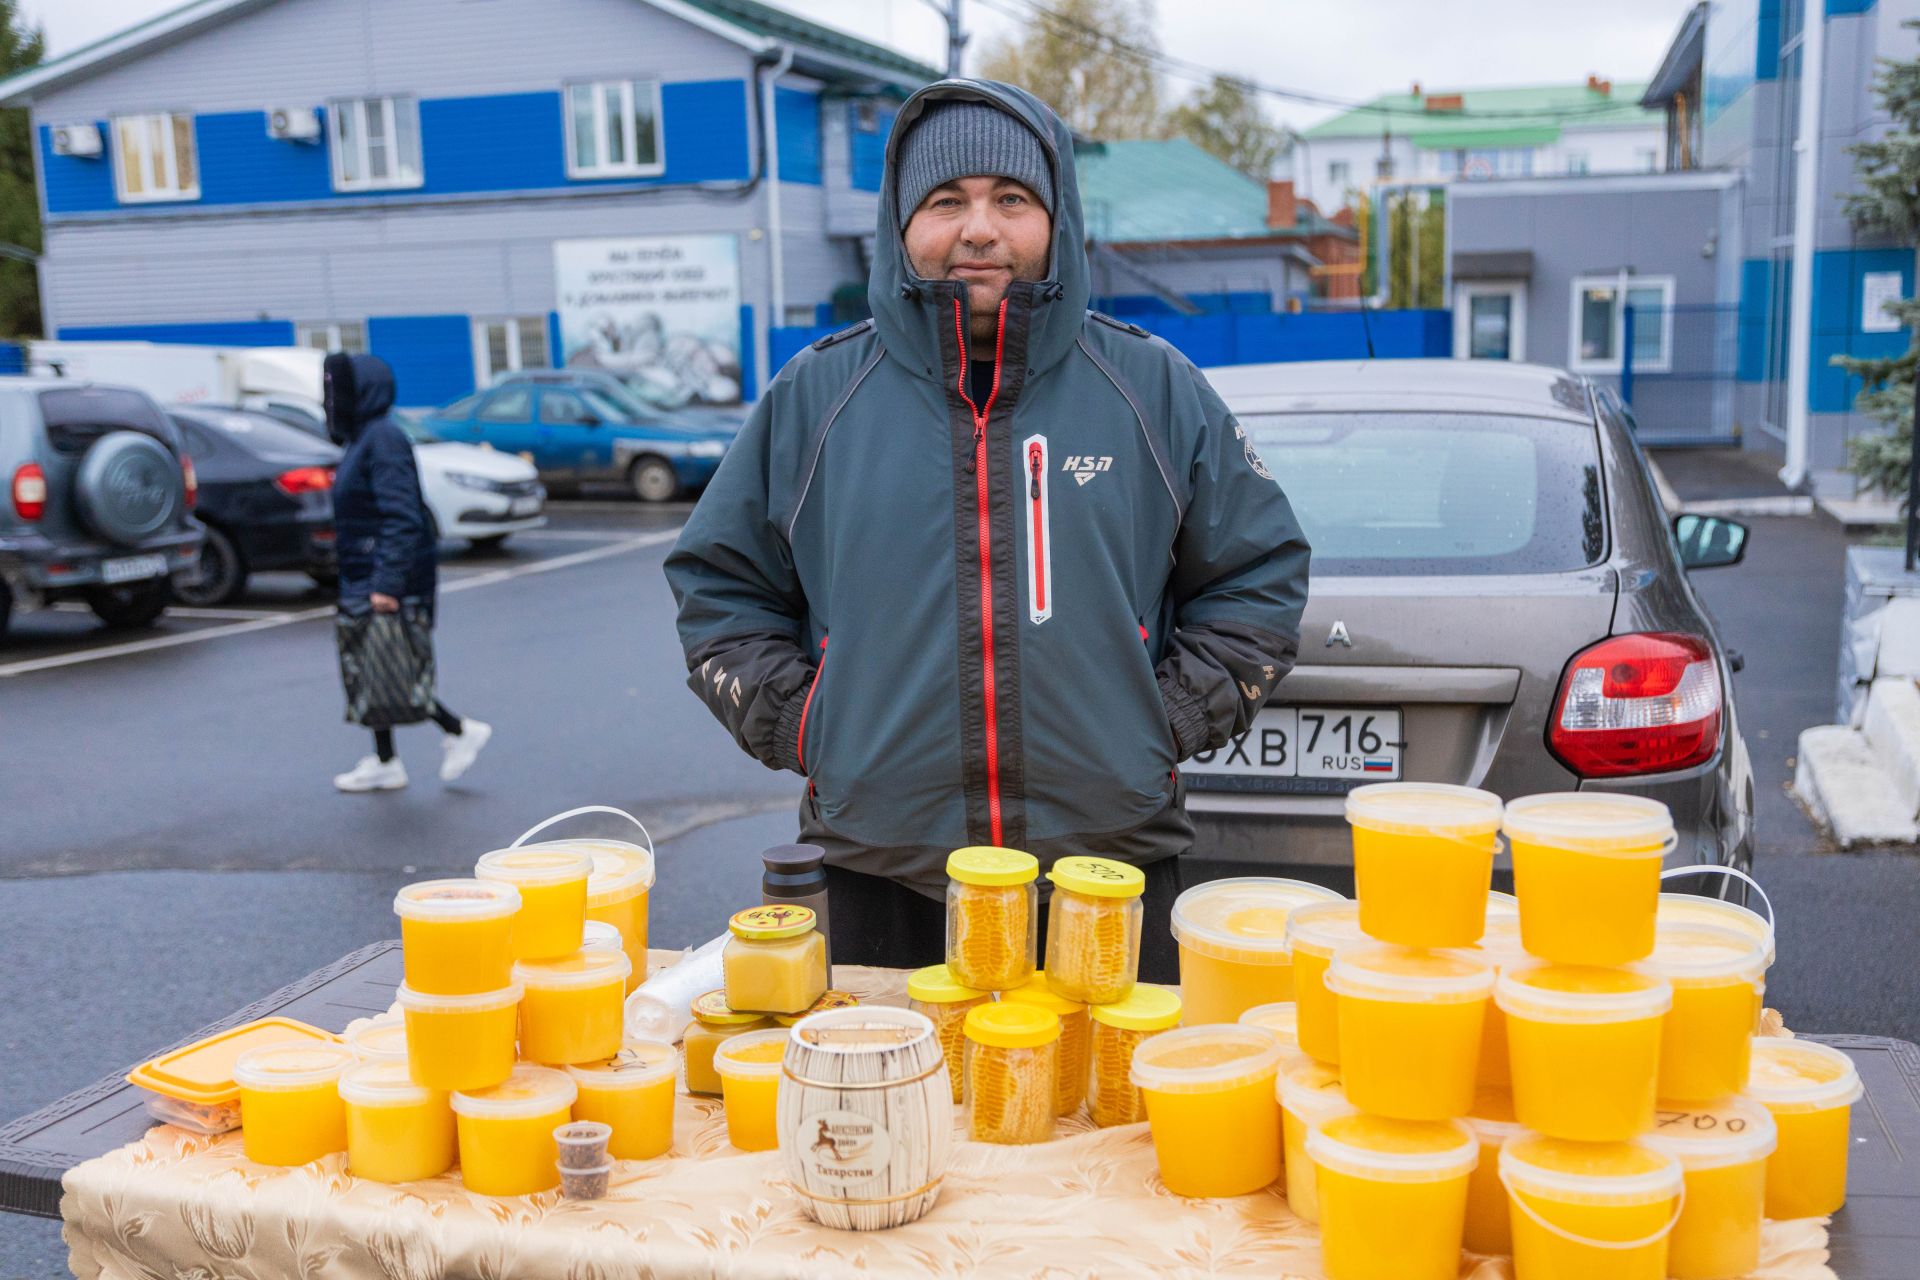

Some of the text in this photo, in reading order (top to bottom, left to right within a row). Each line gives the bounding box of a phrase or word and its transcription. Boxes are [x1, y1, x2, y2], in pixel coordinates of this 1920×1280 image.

[1326, 620, 1352, 648] A
[1302, 715, 1381, 754] 716
[1323, 756, 1361, 770] RUS
[1655, 1111, 1746, 1132] 700
[816, 1164, 873, 1178] Татарстан
